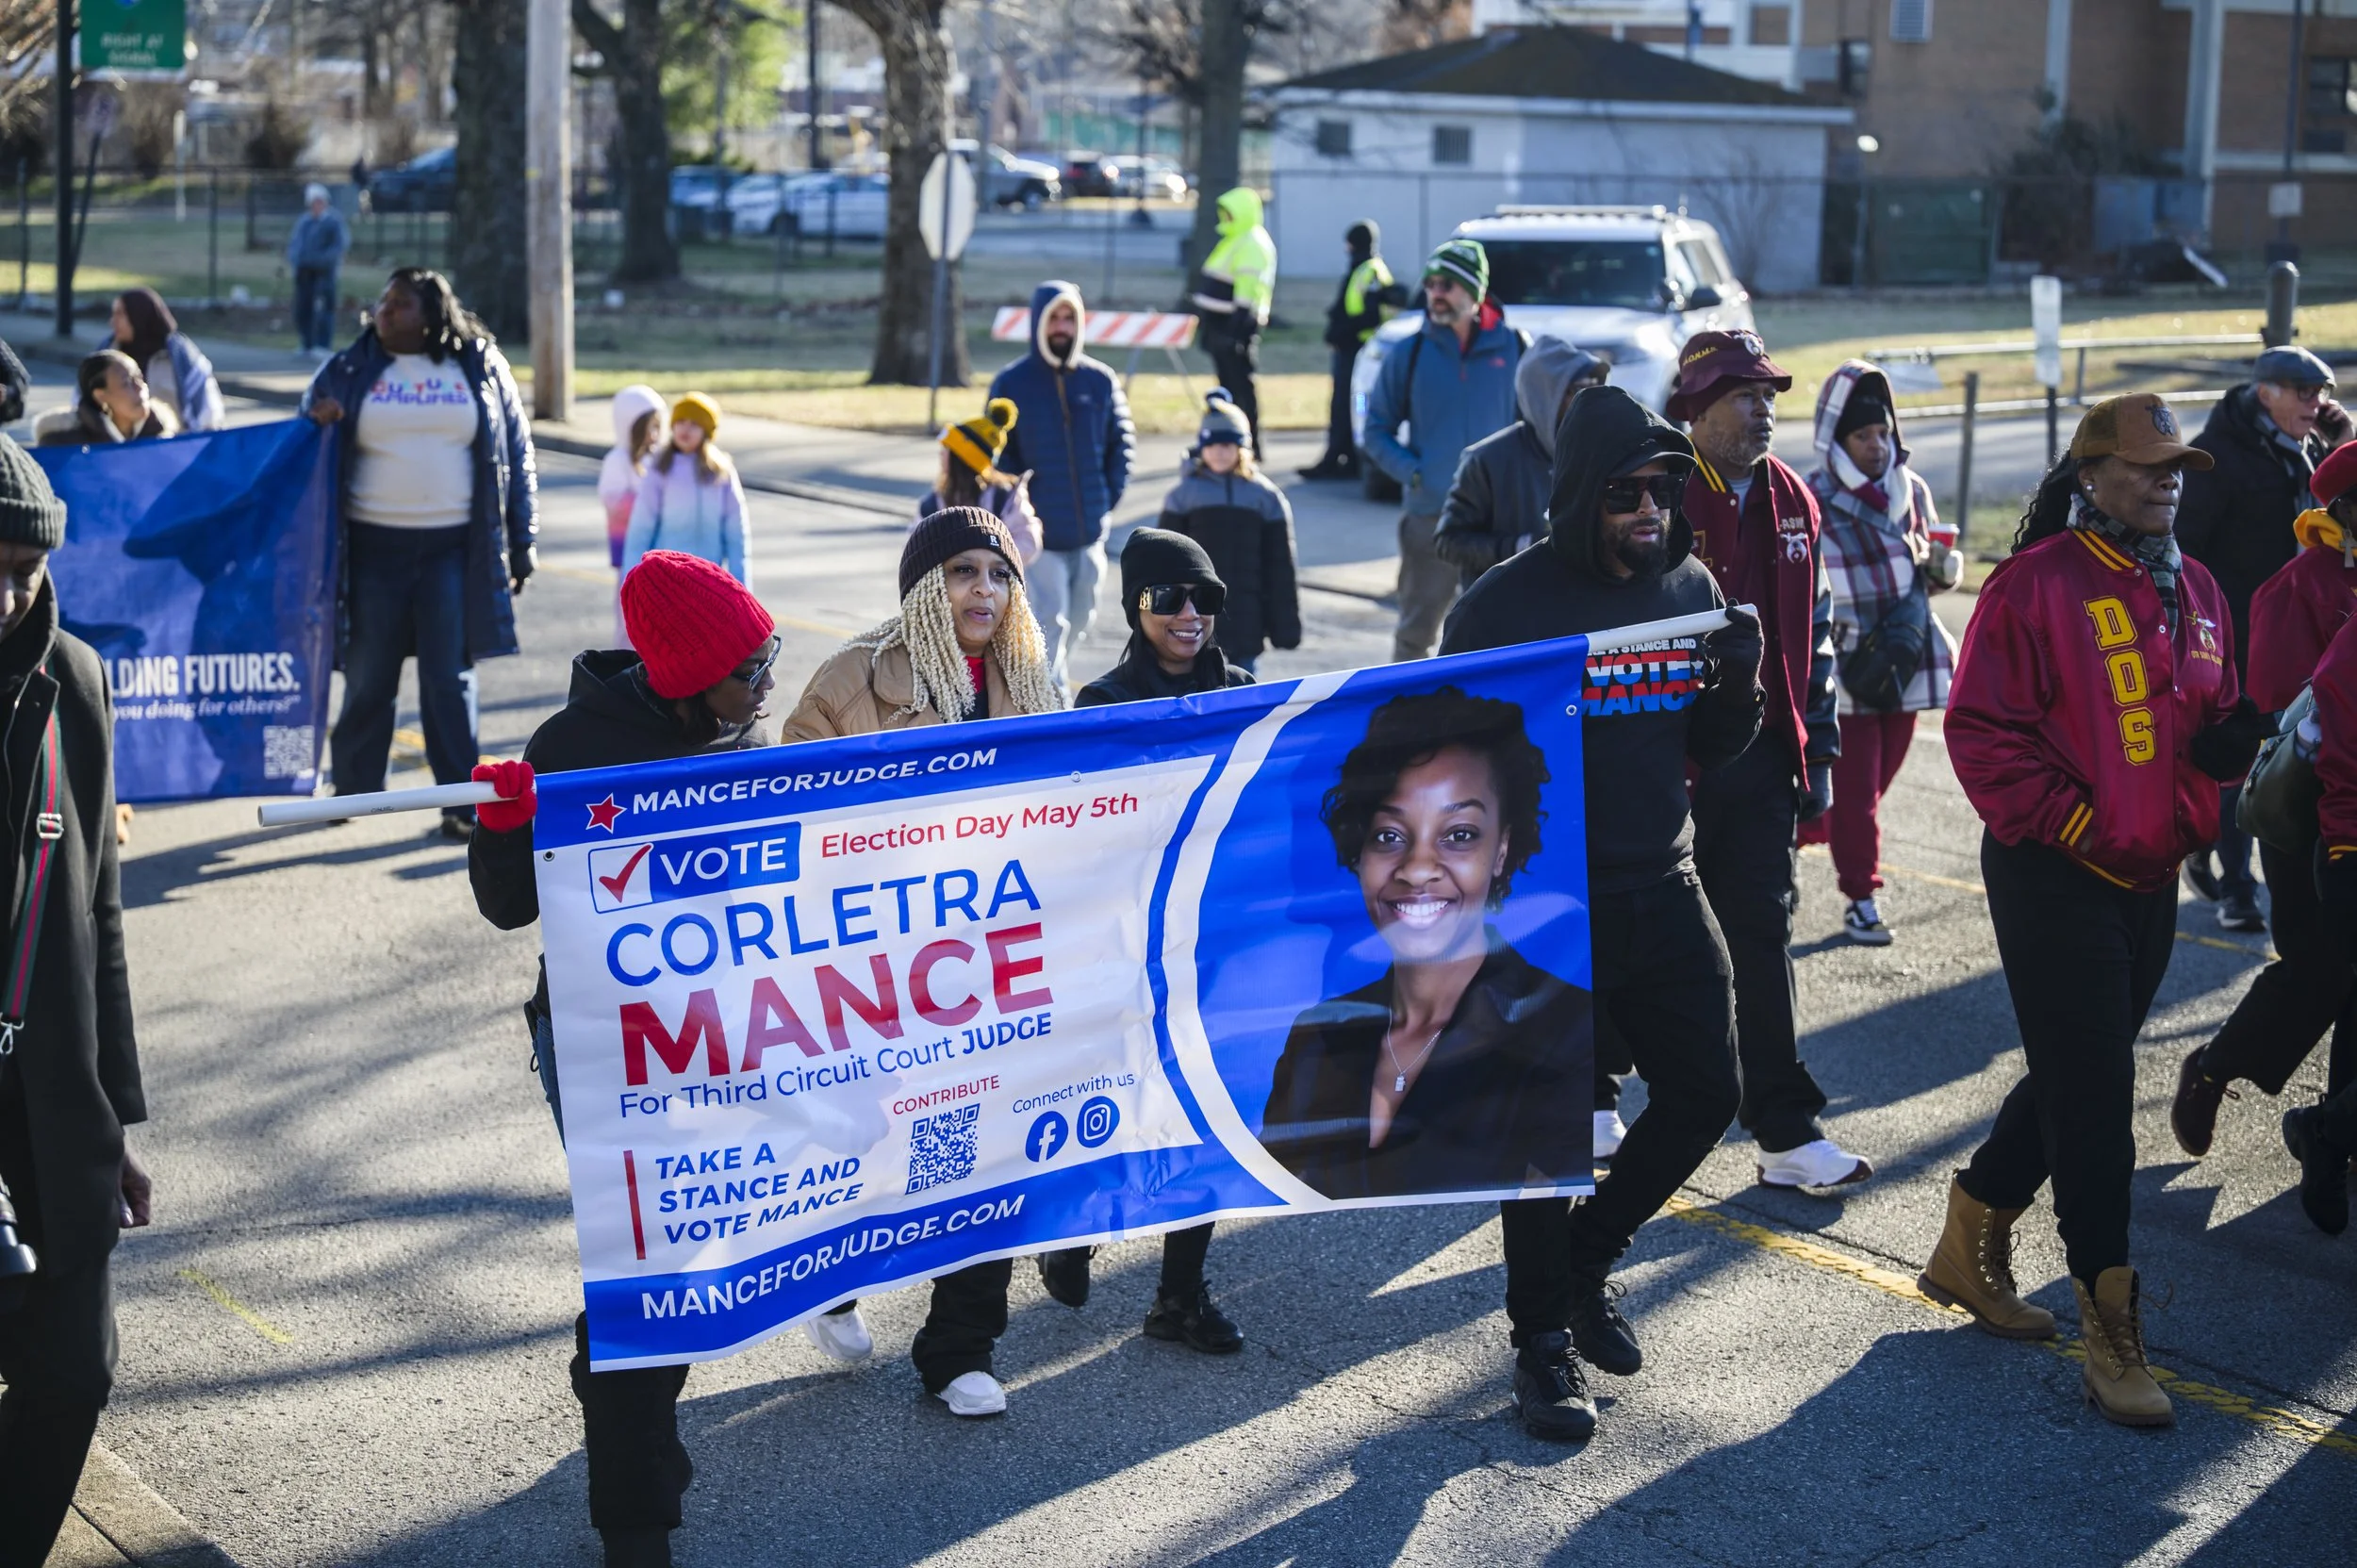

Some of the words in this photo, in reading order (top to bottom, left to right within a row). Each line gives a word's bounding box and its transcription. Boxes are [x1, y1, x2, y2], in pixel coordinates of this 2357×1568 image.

[1585, 650, 1690, 686] VOTE
[1673, 638, 1696, 650] AND
[184, 652, 301, 695] FUTURES.
[2083, 595, 2157, 767] DOS
[144, 699, 196, 721] doing
[197, 698, 223, 717] for
[633, 748, 997, 815] MANCEFORJUDGE.COM
[821, 825, 945, 858] Election
[955, 813, 1014, 839] Day
[1023, 805, 1083, 829] May
[1090, 793, 1138, 818] 5th
[660, 837, 786, 885] VOTE
[606, 859, 1042, 987] CORLETRA
[618, 922, 1053, 1086] MANCE
[619, 1092, 673, 1118] For
[681, 1074, 767, 1109] Third
[776, 1055, 871, 1097] Circuit
[877, 1037, 955, 1074] Court
[961, 1013, 1052, 1055] JUDGE
[1013, 1085, 1073, 1114] Connect
[1077, 1074, 1113, 1097] with
[1116, 1073, 1136, 1086] us
[892, 1074, 1000, 1116] CONTRIBUTE
[655, 1146, 742, 1180] TAKE
[752, 1142, 776, 1166] A
[659, 1172, 790, 1213] STANCE
[796, 1157, 861, 1191] AND
[664, 1212, 751, 1245] VOTE
[756, 1182, 864, 1228] MANCE
[641, 1194, 1026, 1320] MANCEFORJUDGE.COM
